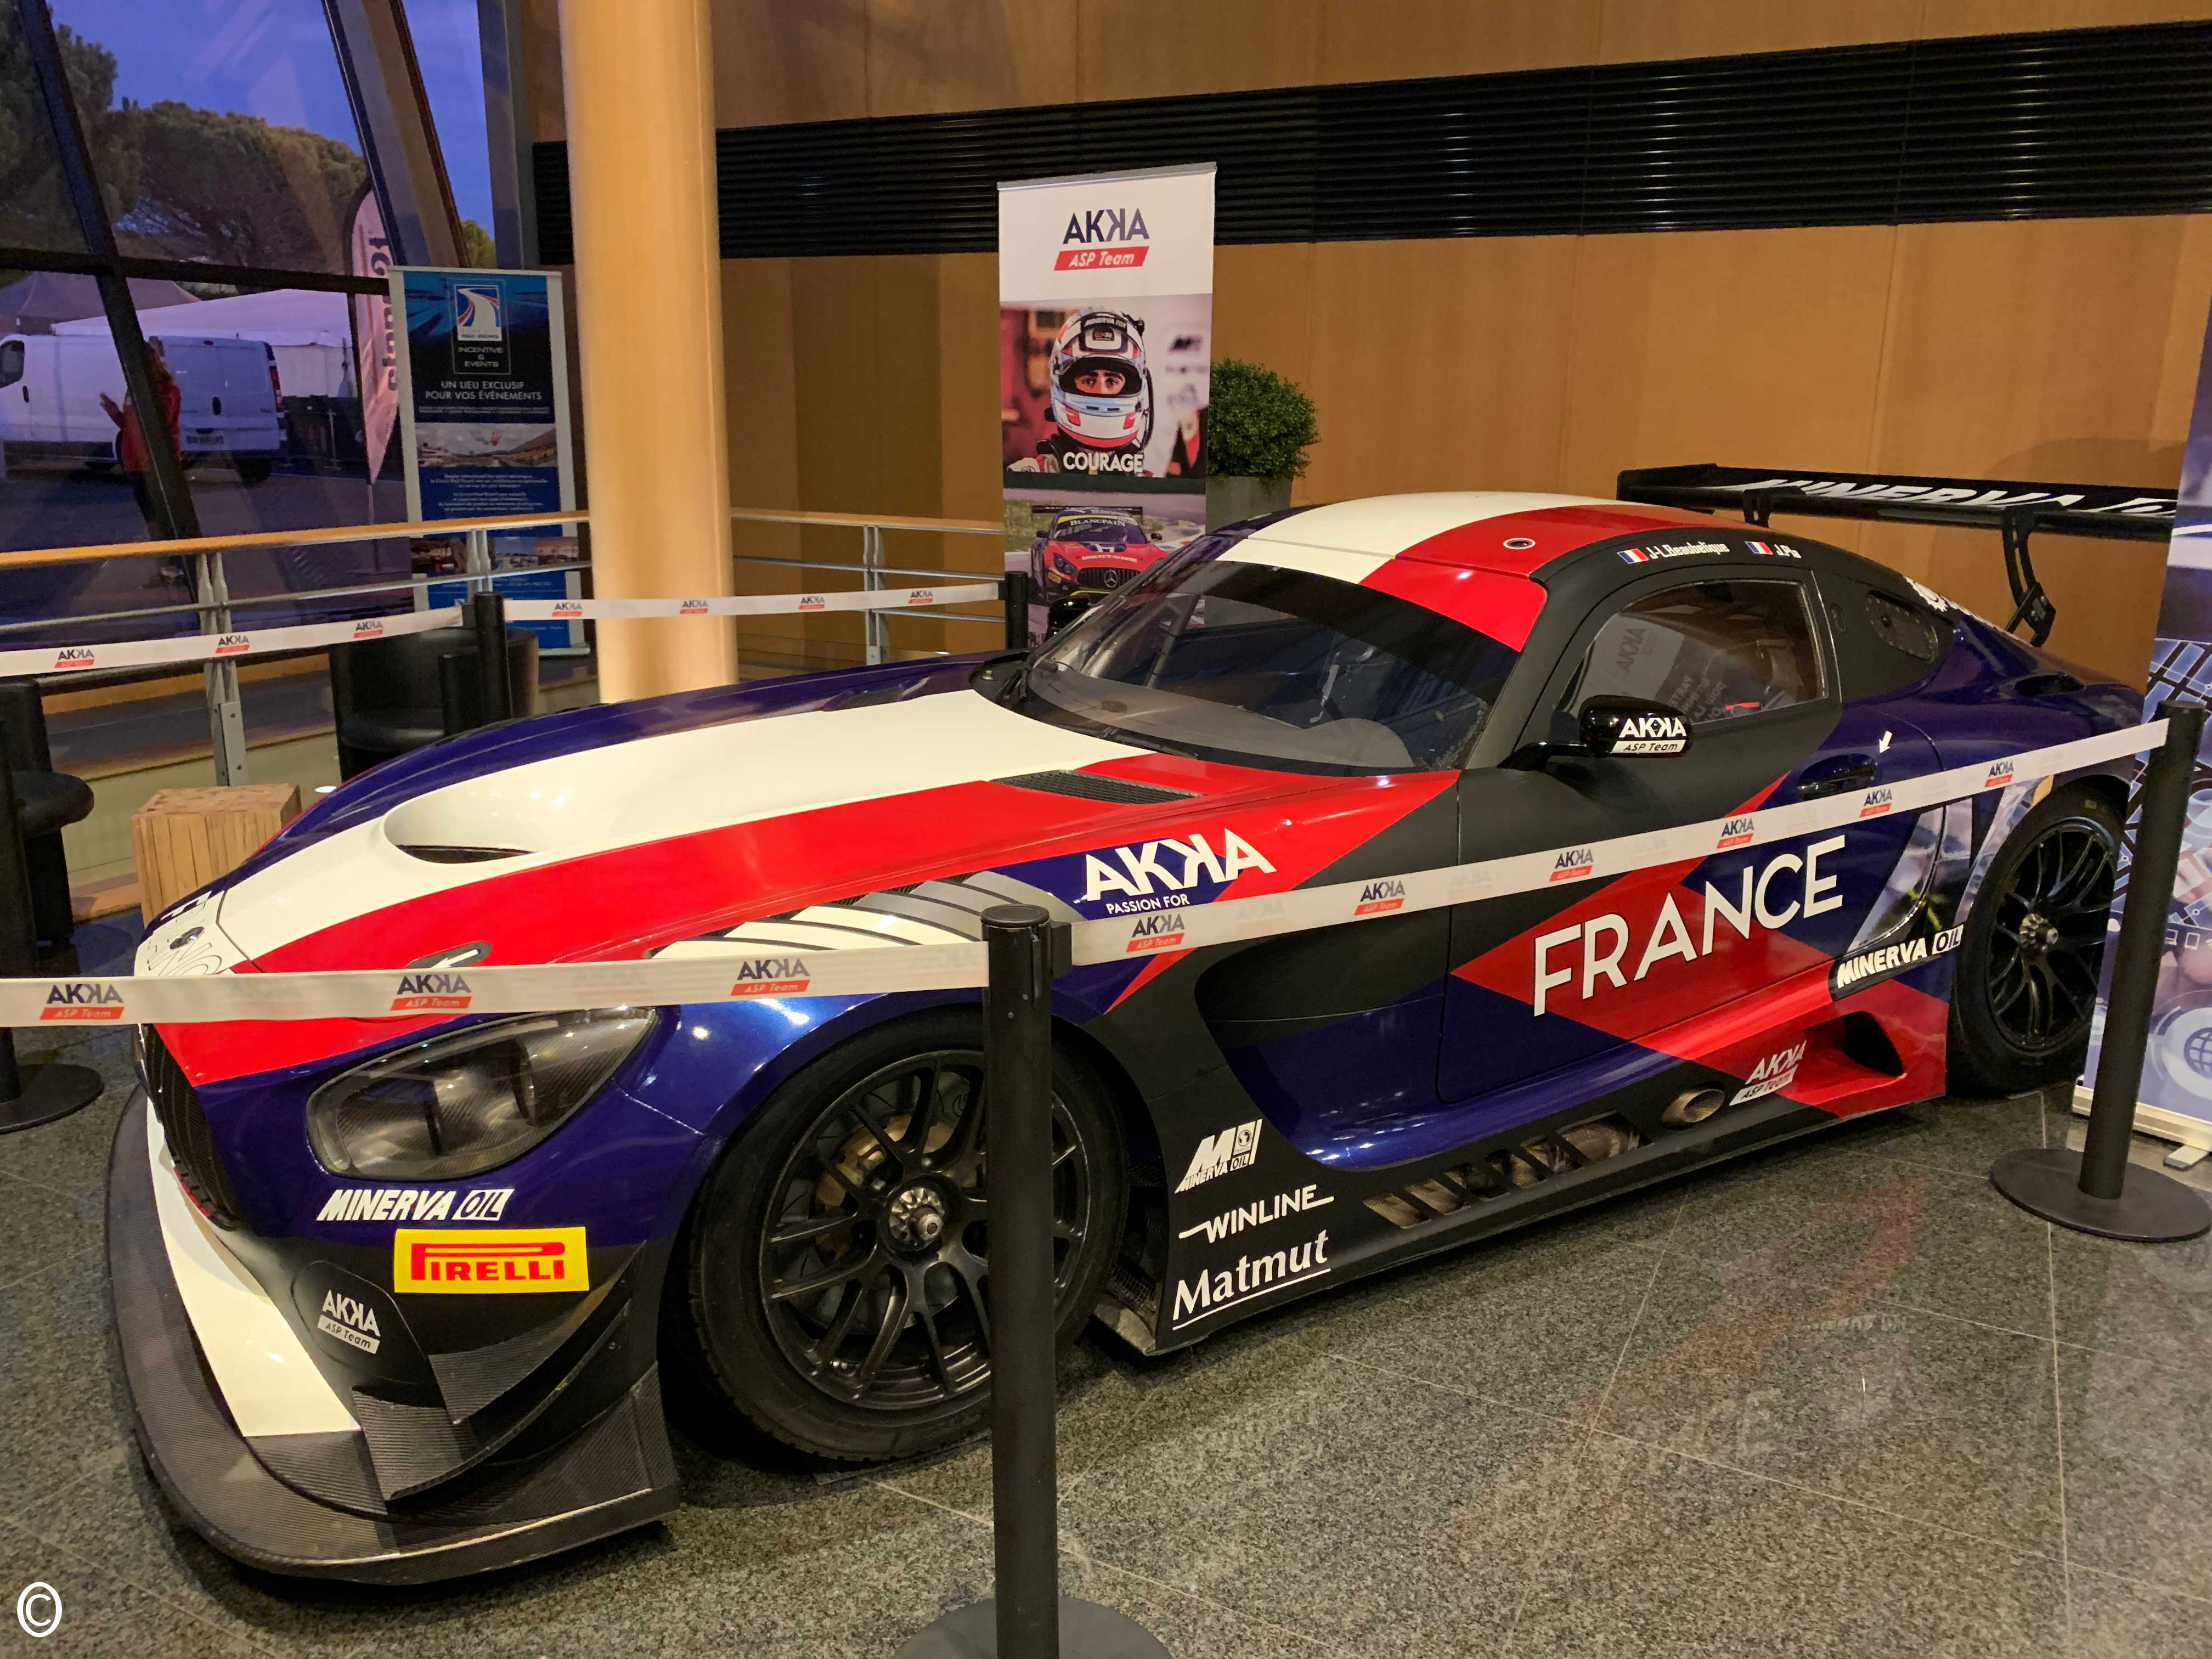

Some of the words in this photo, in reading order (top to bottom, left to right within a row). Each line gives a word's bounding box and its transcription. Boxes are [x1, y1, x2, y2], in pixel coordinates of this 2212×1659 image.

[1063, 207, 1149, 244] AKKA
[1069, 254, 1095, 268] ASP
[1099, 251, 1135, 266] Team
[425, 391, 452, 399] POUR
[455, 391, 476, 399] VOS
[441, 381, 456, 389] UN
[482, 381, 524, 390] EXCLUSIF
[1063, 452, 1143, 472] COURAGE
[1070, 518, 1125, 527] BLANCPAIN
[58, 649, 94, 660] AKKA
[1619, 718, 1686, 738] AKKA
[1624, 743, 1645, 751] ASP
[1649, 743, 1678, 751] Team
[1086, 828, 1277, 901] AKKA
[1554, 849, 1593, 869] AKKA
[1360, 880, 1405, 902] AKKA
[1106, 898, 1161, 914] PASSION
[1163, 894, 1190, 907] FOR
[1132, 913, 1185, 938] AKKA
[1534, 835, 1845, 1017] FRANCE
[1136, 939, 1152, 949] ASP
[1837, 937, 1928, 989] MINERVA
[1934, 927, 1961, 953] OIL
[737, 958, 810, 980] AKKA
[46, 984, 124, 1004] AKKA
[397, 974, 472, 995] AKKA
[744, 984, 766, 993] ASP
[770, 983, 798, 991] Team
[54, 1009, 78, 1018] ASP
[82, 1008, 111, 1018] Team
[405, 998, 428, 1008] ASP
[432, 998, 460, 1007] Team
[1175, 1161, 1228, 1193] MINERVA
[1231, 1154, 1249, 1171] OIL
[317, 1189, 456, 1220] MINERVA
[454, 1189, 512, 1220] OIL
[1179, 1184, 1334, 1243] WINLINE
[411, 1242, 566, 1280] PIRELLI
[1173, 1229, 1329, 1321] Matmut
[322, 1289, 381, 1337] AKKA
[325, 1322, 342, 1334] ASP
[343, 1329, 371, 1348] Team
